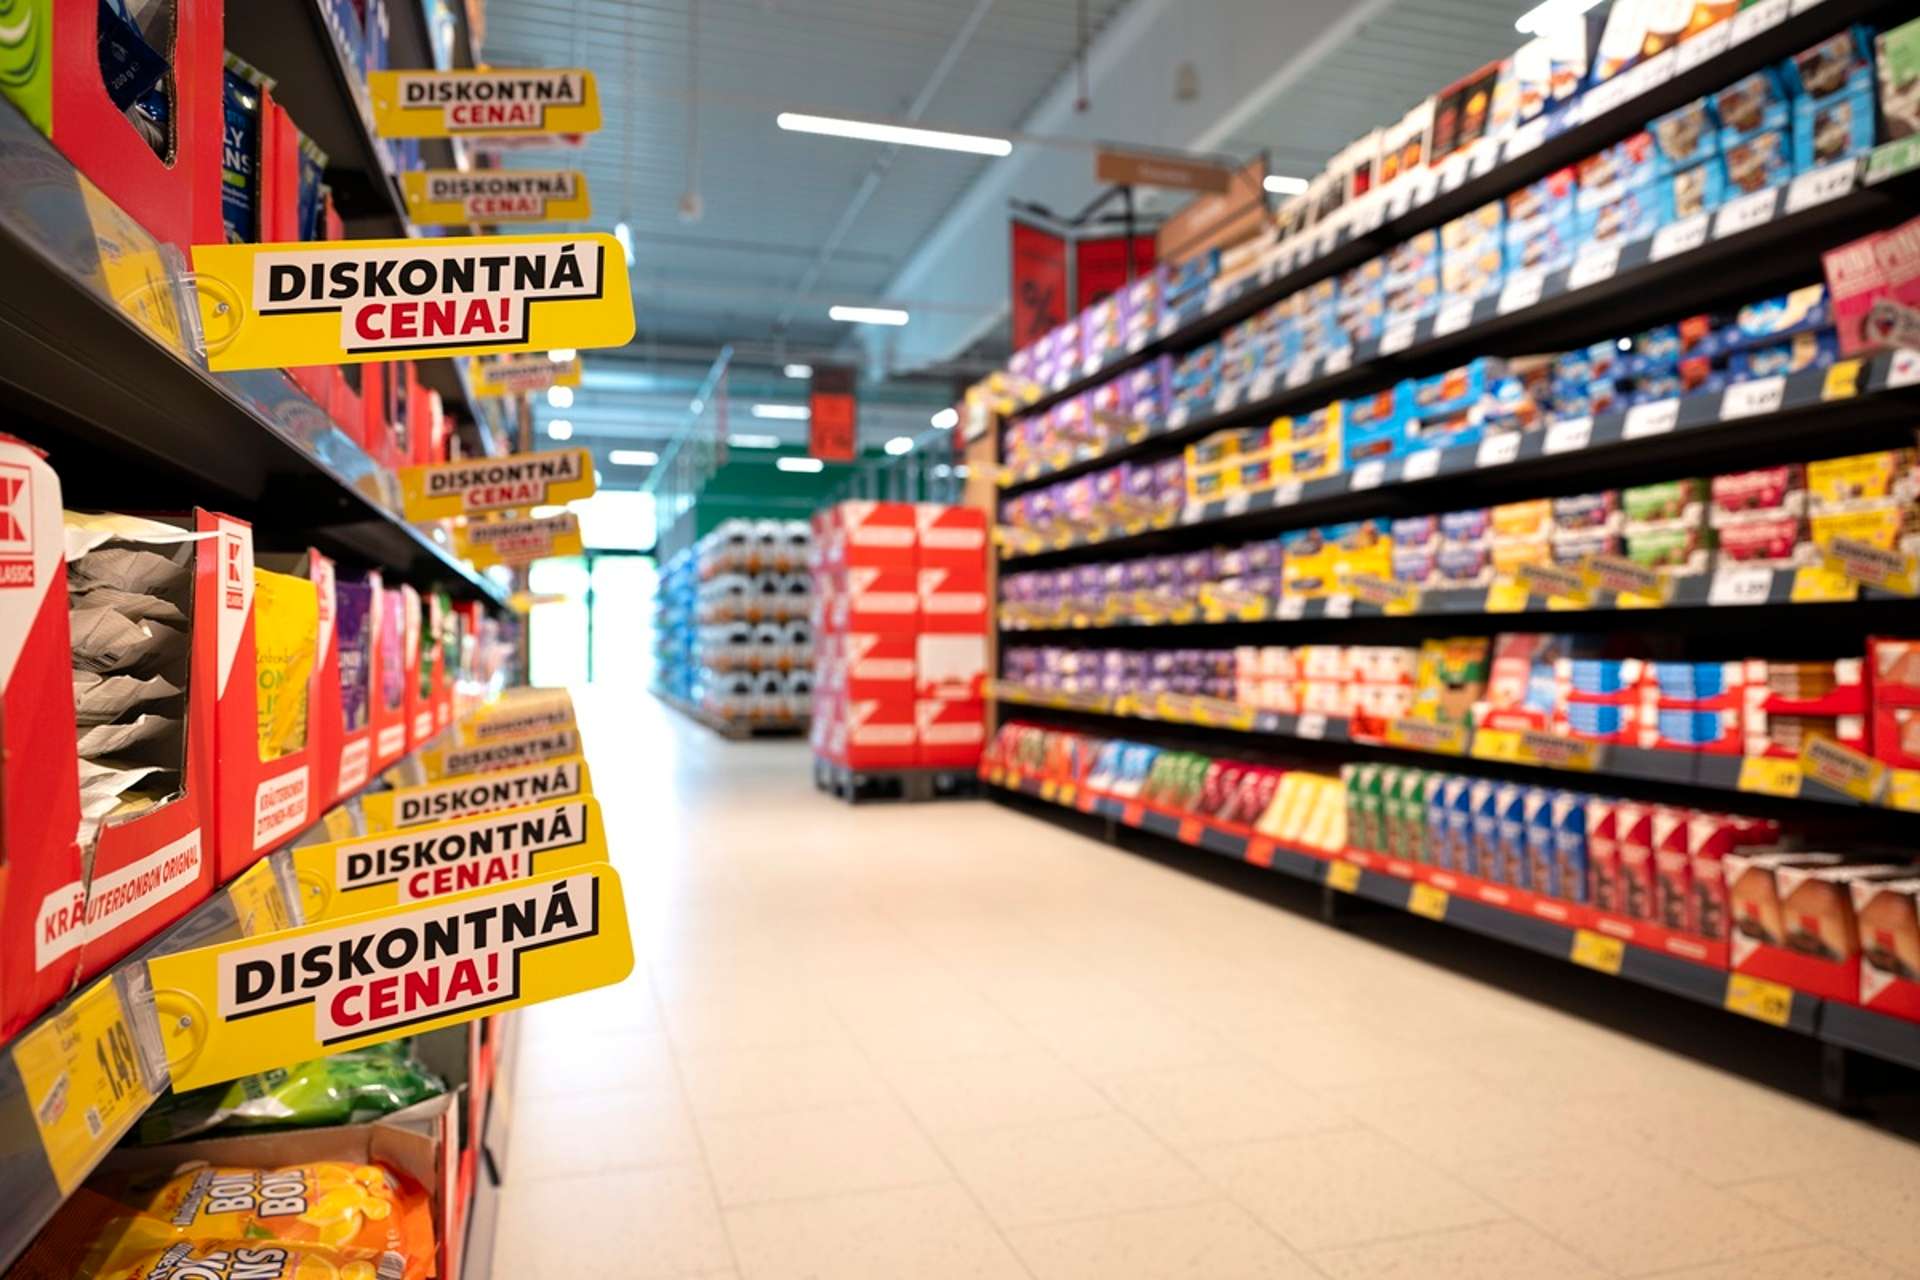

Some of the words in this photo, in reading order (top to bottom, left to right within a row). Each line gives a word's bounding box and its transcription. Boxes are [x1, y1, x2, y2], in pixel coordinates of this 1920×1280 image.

[406, 75, 574, 102] DISKONTNÁ
[452, 104, 536, 125] CENA!
[432, 174, 568, 196] DISKONTNÁ
[469, 198, 538, 214] CENA!
[268, 243, 585, 302] DISKONTNÁ
[354, 298, 511, 341] CENA!
[430, 454, 572, 491] DISKONTNÁ
[467, 482, 540, 506] CENA!
[402, 772, 569, 821] DISKONTNÁ
[347, 806, 573, 882] DISKONTNÁ
[44, 864, 162, 946] KRÄUTERBONBON
[161, 844, 199, 884] ORIGINAL
[408, 853, 520, 899] CENA!
[235, 880, 579, 1006] DISKONTNÁ
[329, 952, 500, 1028] CENA!
